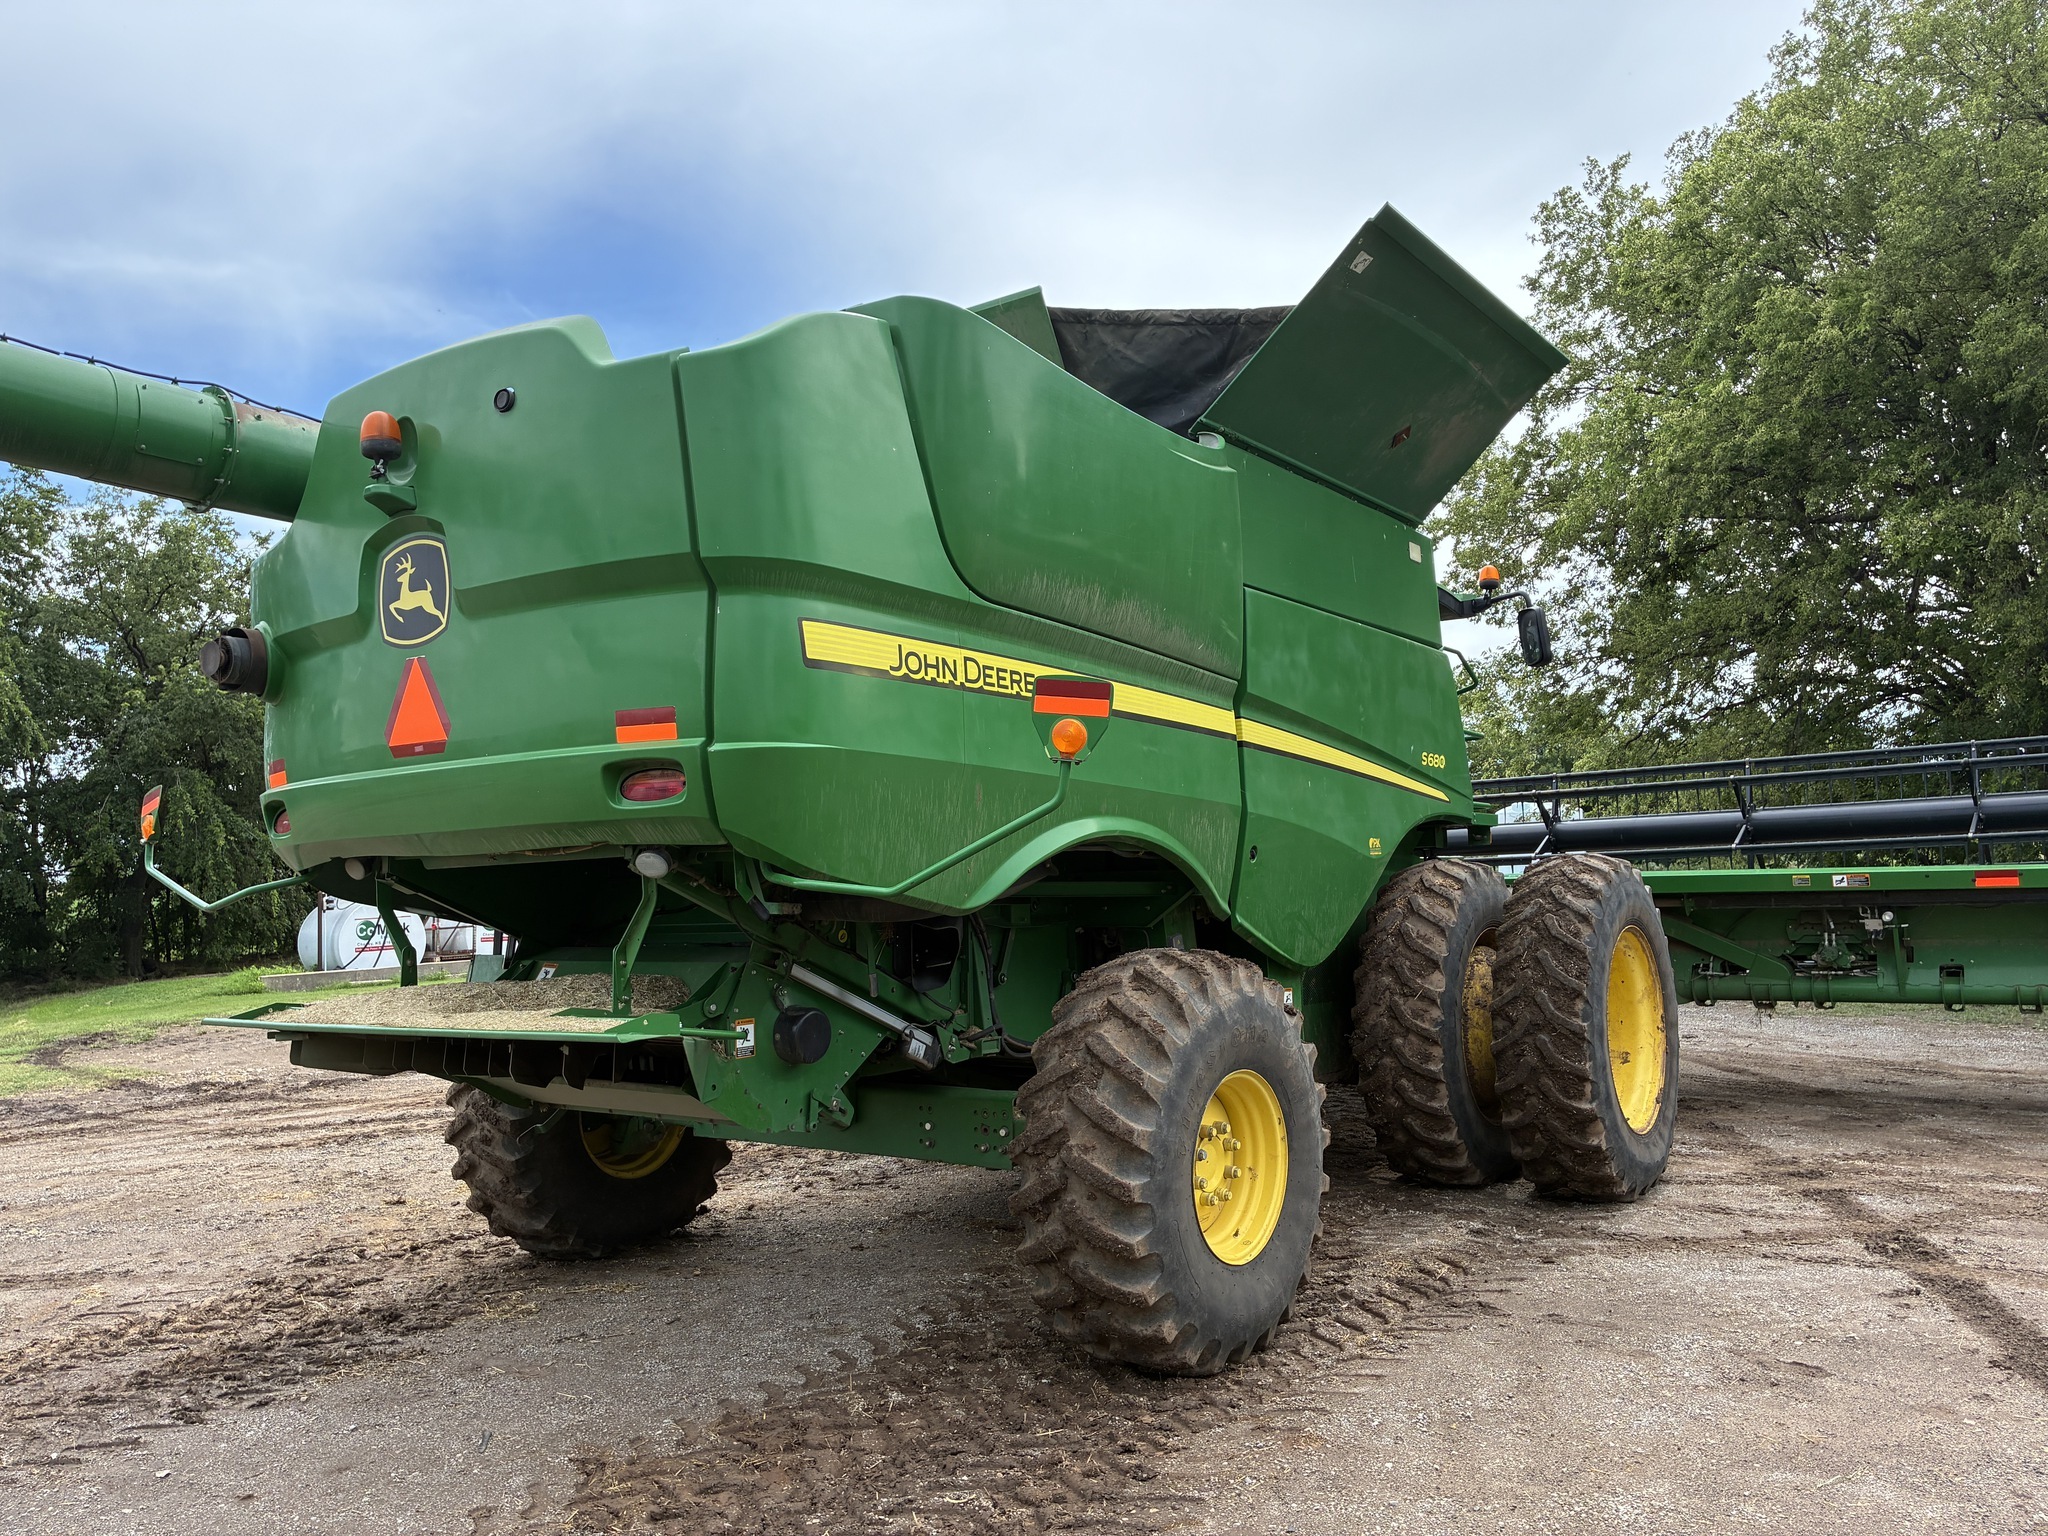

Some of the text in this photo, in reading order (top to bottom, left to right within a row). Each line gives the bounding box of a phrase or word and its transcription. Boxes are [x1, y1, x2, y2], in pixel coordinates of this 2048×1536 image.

[889, 643, 1035, 693] JOHN DEERE
[1421, 751, 1446, 769] S680
[357, 922, 410, 937] CoMk
